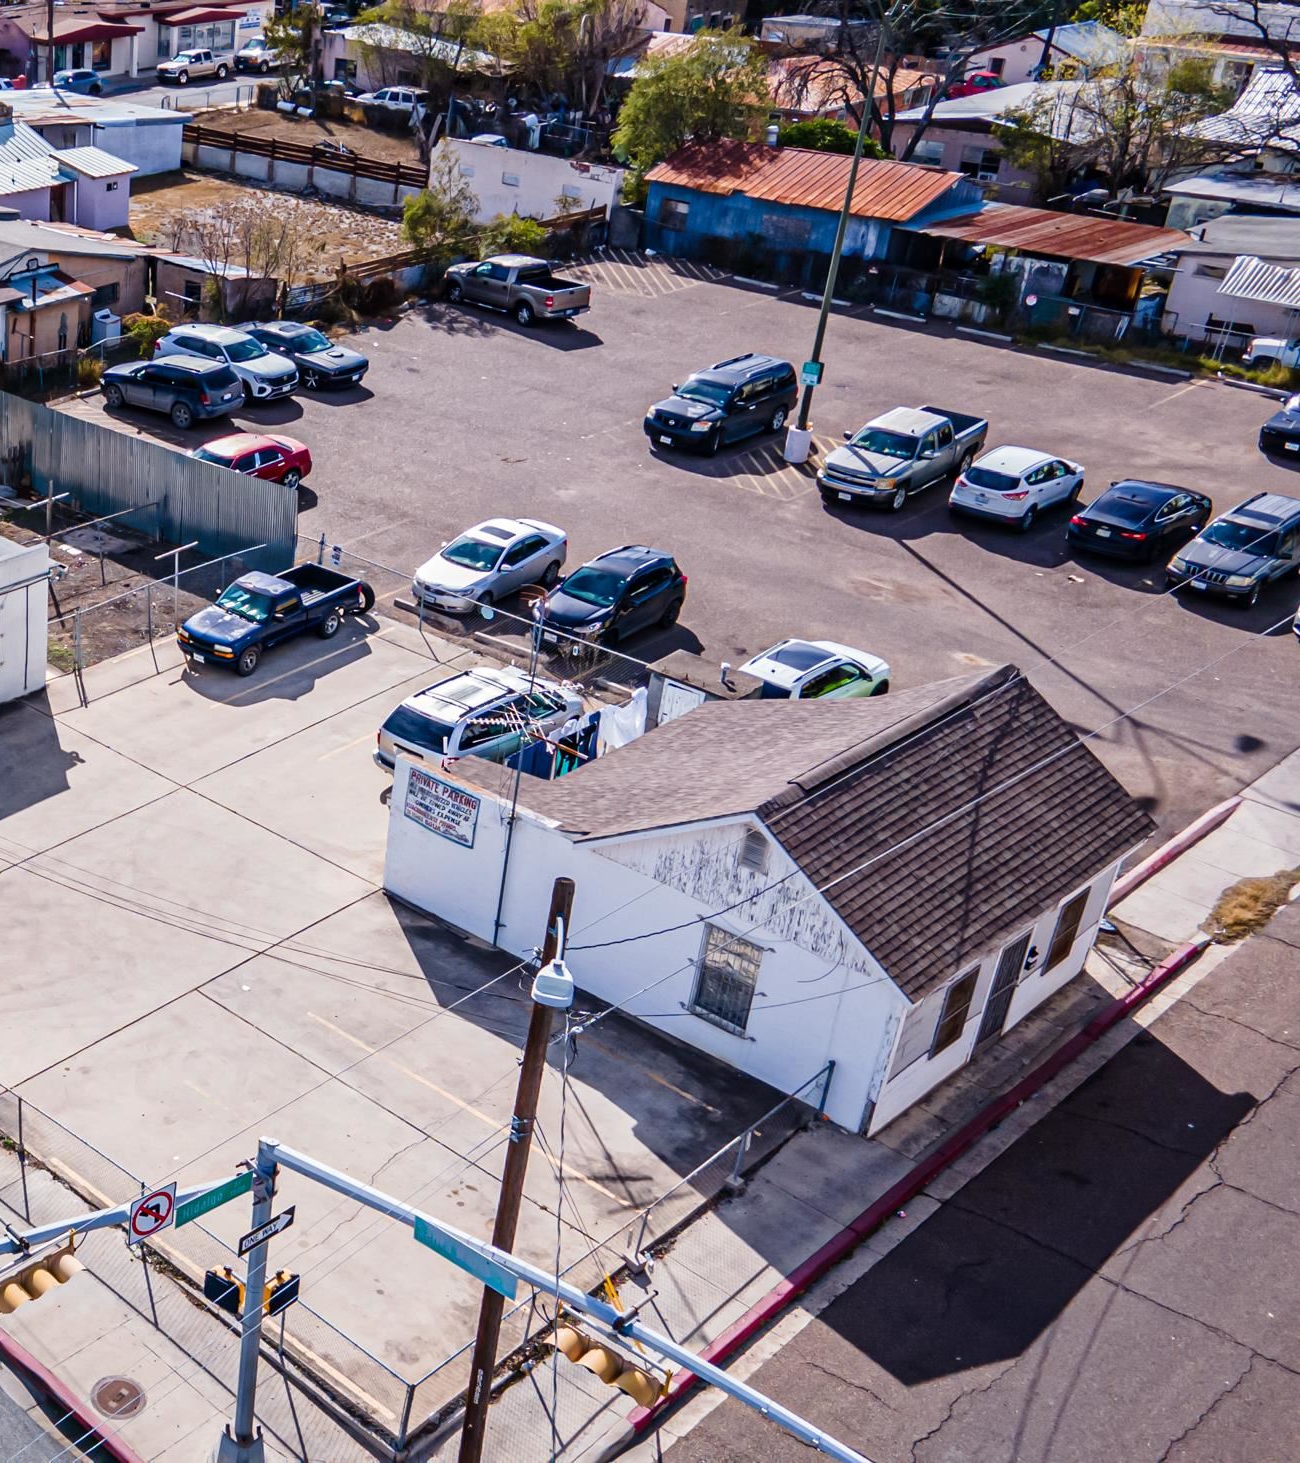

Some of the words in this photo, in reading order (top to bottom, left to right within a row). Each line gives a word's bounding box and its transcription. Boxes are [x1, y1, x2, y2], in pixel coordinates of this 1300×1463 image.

[411, 770, 440, 794] PRIVATE
[442, 786, 477, 810] PARKING
[428, 800, 446, 811] TOWED
[436, 811, 462, 826] EXPENSE
[243, 1234, 259, 1249] ONE
[262, 1222, 279, 1237] WAY
